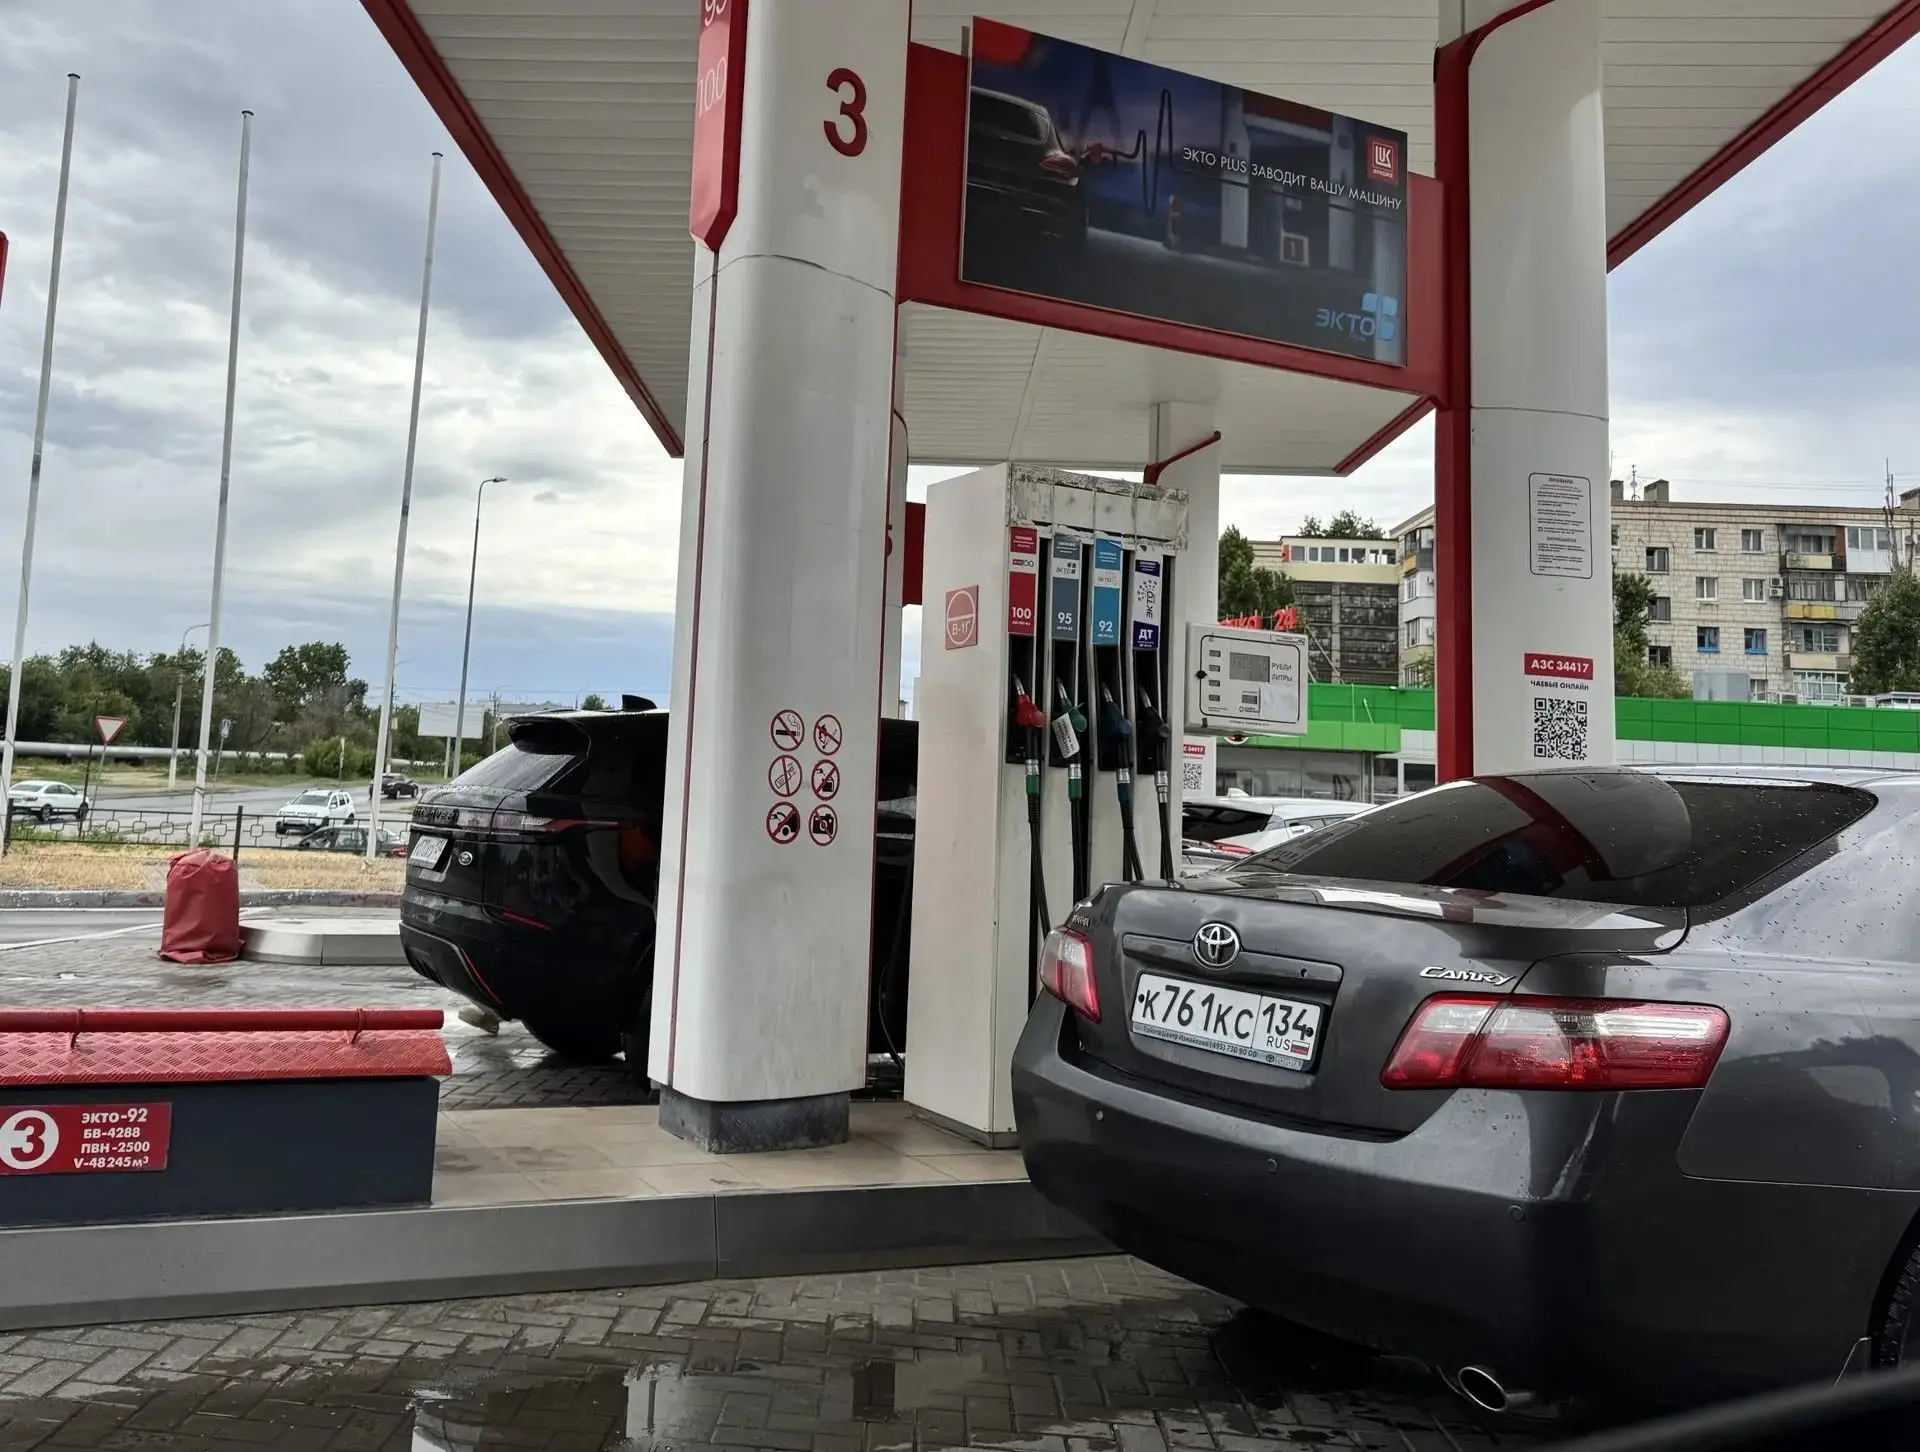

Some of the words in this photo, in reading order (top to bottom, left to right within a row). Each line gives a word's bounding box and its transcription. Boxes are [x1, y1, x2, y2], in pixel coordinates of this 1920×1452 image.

[697, 56, 728, 117] 100
[824, 68, 867, 157] 3
[1183, 147, 1216, 166] ЭКТО
[1220, 156, 1247, 174] PLUS
[1251, 163, 1307, 188] ЗАВОДИТ
[1310, 178, 1345, 199] ВАШУ
[1348, 187, 1402, 211] МАШИНУ
[1316, 308, 1375, 336] ЭКТО
[1146, 591, 1154, 618] ЭКТО
[1012, 607, 1032, 619] 100
[1058, 612, 1072, 624] 95
[1099, 620, 1113, 632] 92
[1138, 628, 1153, 640] ДТ
[1531, 659, 1554, 670] АЗС
[1556, 661, 1589, 673] 34417
[1530, 680, 1558, 689] ЧАЕВЫЕ
[1560, 682, 1589, 691] ОНЛАЙН
[1142, 985, 1253, 1039] К761КС
[1263, 1002, 1307, 1040] 134
[1209, 1041, 1226, 1052] (495)
[1226, 1045, 1238, 1053] 730
[1238, 1047, 1248, 1055] 90
[1248, 1049, 1257, 1057] 00
[1266, 1036, 1290, 1050] RUS
[81, 1108, 148, 1124] ЭКТО-92
[10, 1117, 46, 1162] 3
[83, 1127, 141, 1139] БВ-4288
